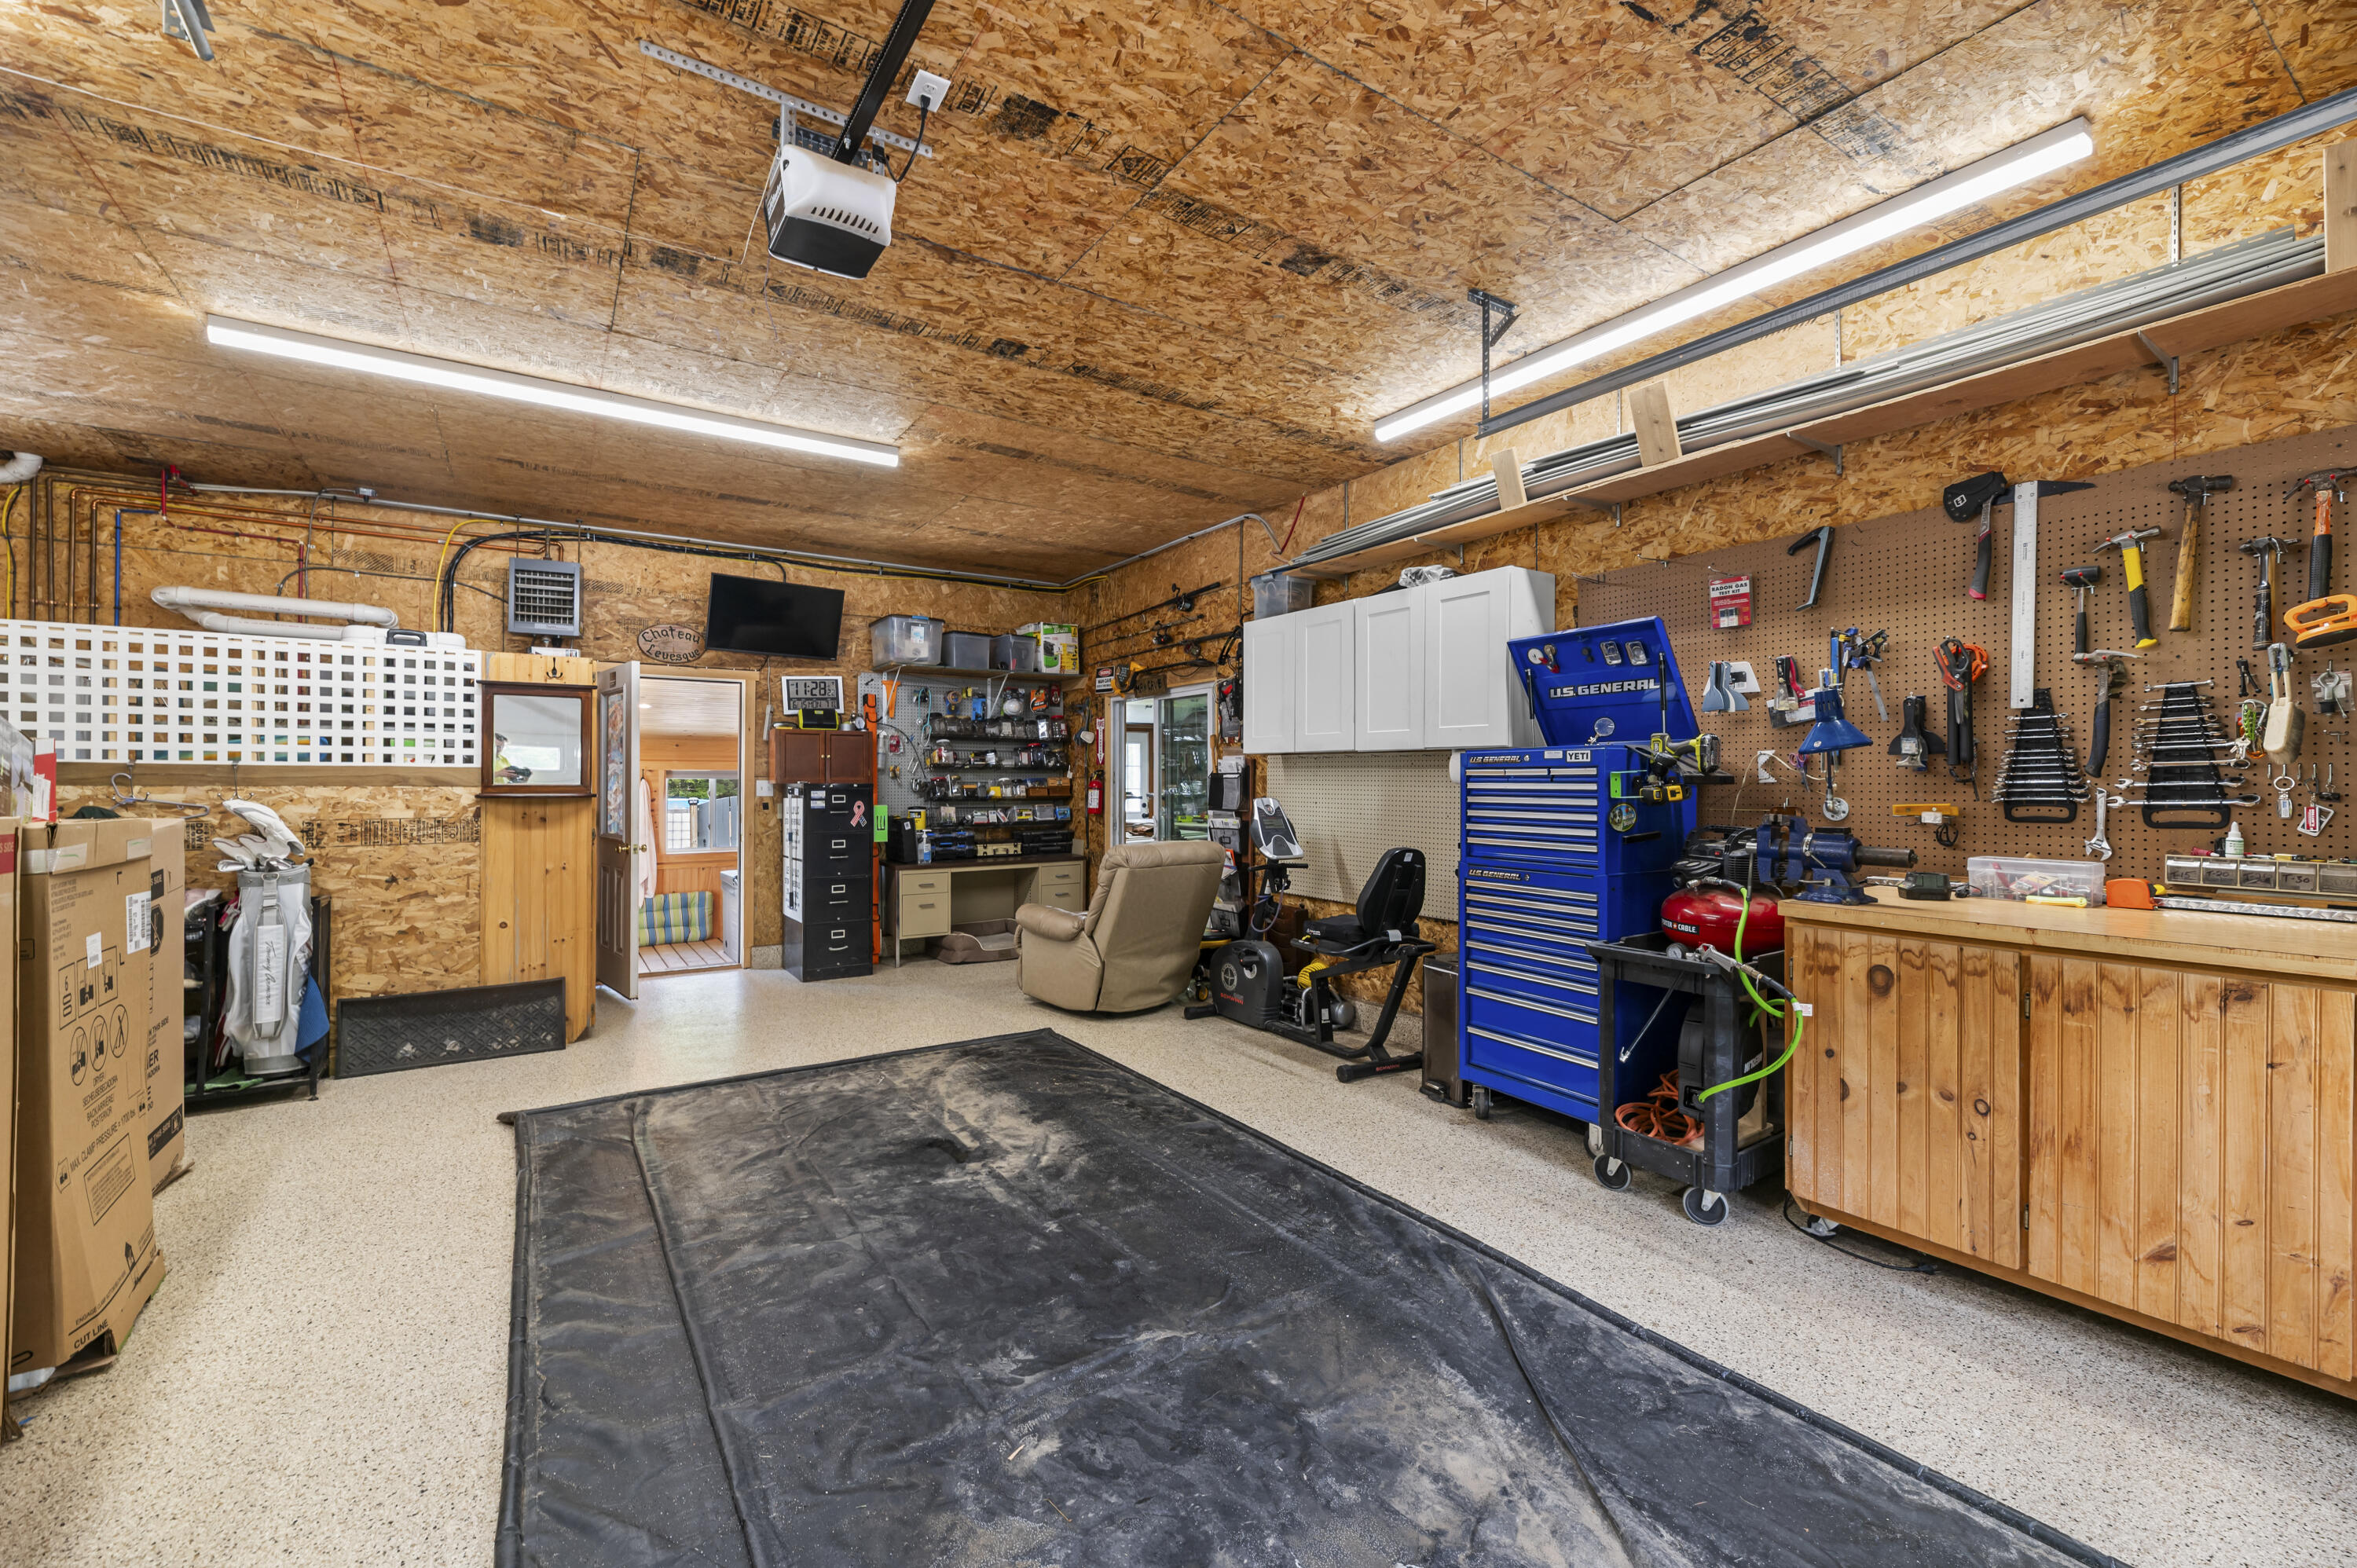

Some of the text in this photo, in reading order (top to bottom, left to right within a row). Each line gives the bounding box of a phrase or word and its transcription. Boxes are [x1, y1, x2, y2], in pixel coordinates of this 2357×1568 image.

[641, 625, 701, 644] Chateau
[1578, 678, 1660, 696] GENERAL
[1483, 755, 1522, 764] GENERAL
[1567, 752, 1589, 760] YETI
[4, 841, 14, 853] SIDE
[154, 874, 163, 885] SIDE
[1483, 870, 1522, 881] GENERAL
[2282, 874, 2311, 884] T-30
[1677, 923, 1698, 933] CABLE
[262, 940, 277, 973] Tommy
[1220, 992, 1244, 1006] SCHWINN
[81, 1141, 96, 1162] CLAMP
[95, 1121, 119, 1150] PRESSURE
[74, 1318, 109, 1350] CUT LINE
